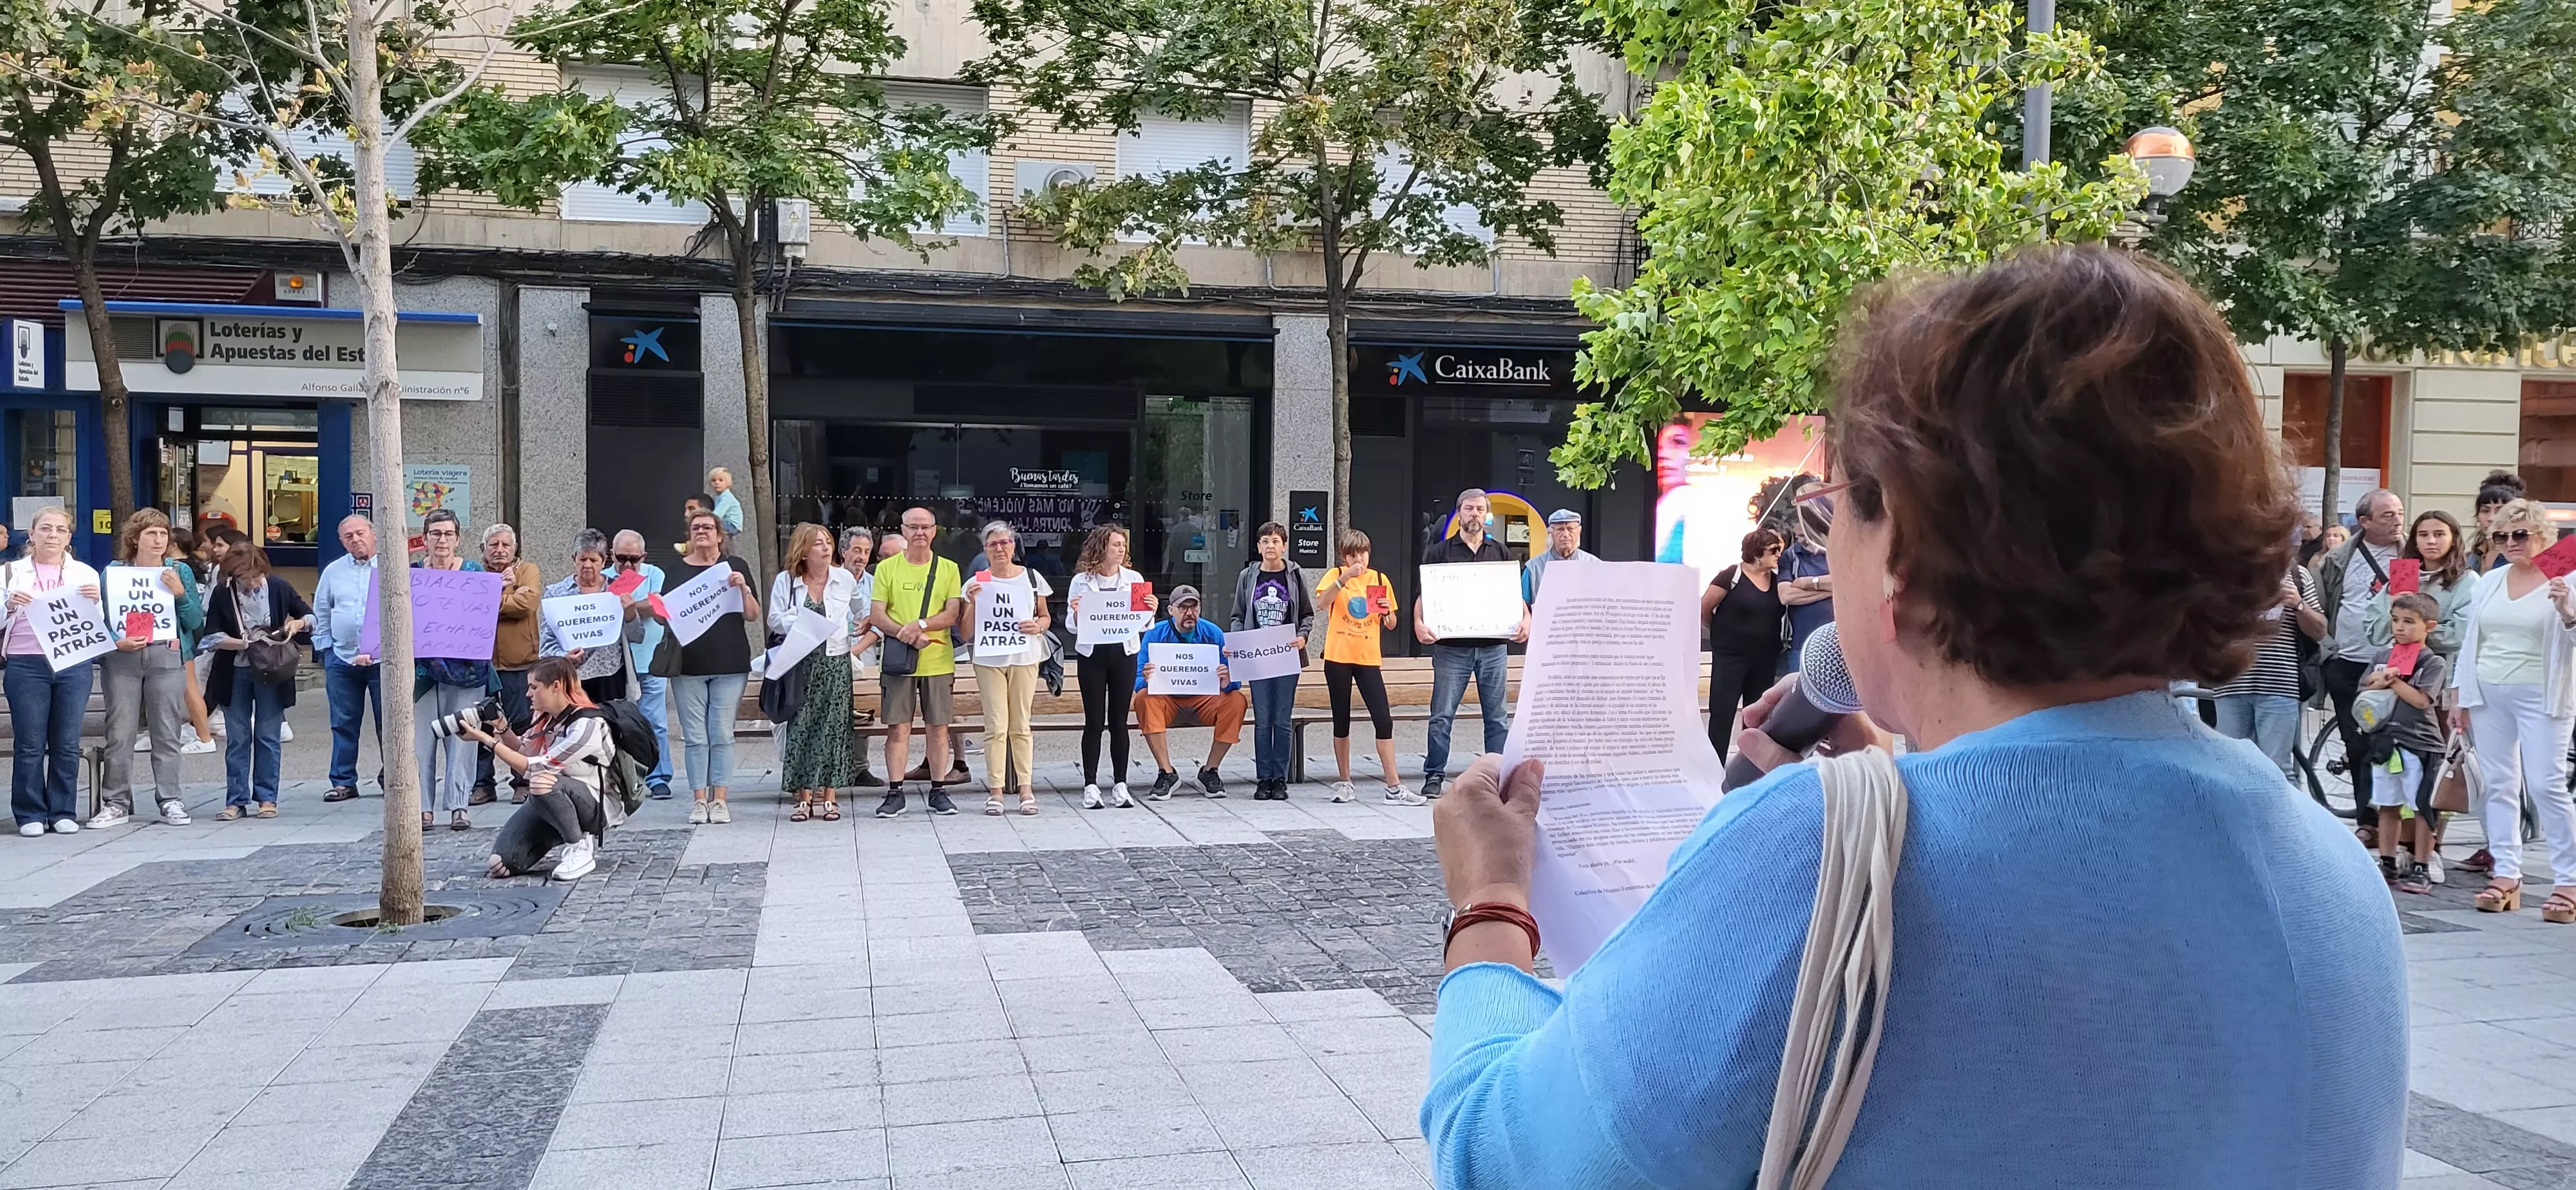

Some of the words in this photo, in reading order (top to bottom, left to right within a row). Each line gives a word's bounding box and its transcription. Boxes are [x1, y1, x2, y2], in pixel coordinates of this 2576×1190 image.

[211, 321, 286, 339] Loterías
[292, 327, 303, 343] y
[211, 343, 296, 363] Apuestas
[302, 345, 330, 361] del
[1435, 355, 1551, 380] CaixaBank
[301, 382, 337, 392] Alfonso
[454, 386, 469, 395] nº6
[1009, 468, 1047, 483] Buenas
[1180, 491, 1213, 500] Store
[132, 578, 149, 587] NI
[129, 590, 153, 600] UN
[689, 583, 708, 598] NOS
[48, 598, 69, 612] NI
[436, 597, 455, 610] TE
[461, 601, 495, 614] VAS
[679, 586, 728, 618] QUEREMOS
[996, 593, 1010, 604] NI
[119, 603, 164, 616] PASO
[574, 603, 596, 612] NOS
[697, 603, 721, 624] VIVAS
[992, 607, 1014, 618] UN
[51, 610, 79, 625] UN
[557, 614, 615, 627] QUEREMOS
[48, 621, 94, 643] PASO
[423, 621, 494, 639] ECHAMOS
[572, 630, 603, 640] VIVAS
[53, 632, 107, 659] ATRÁS
[980, 632, 1027, 647] ATRÁS
[1233, 643, 1291, 659] #SeAcabó
